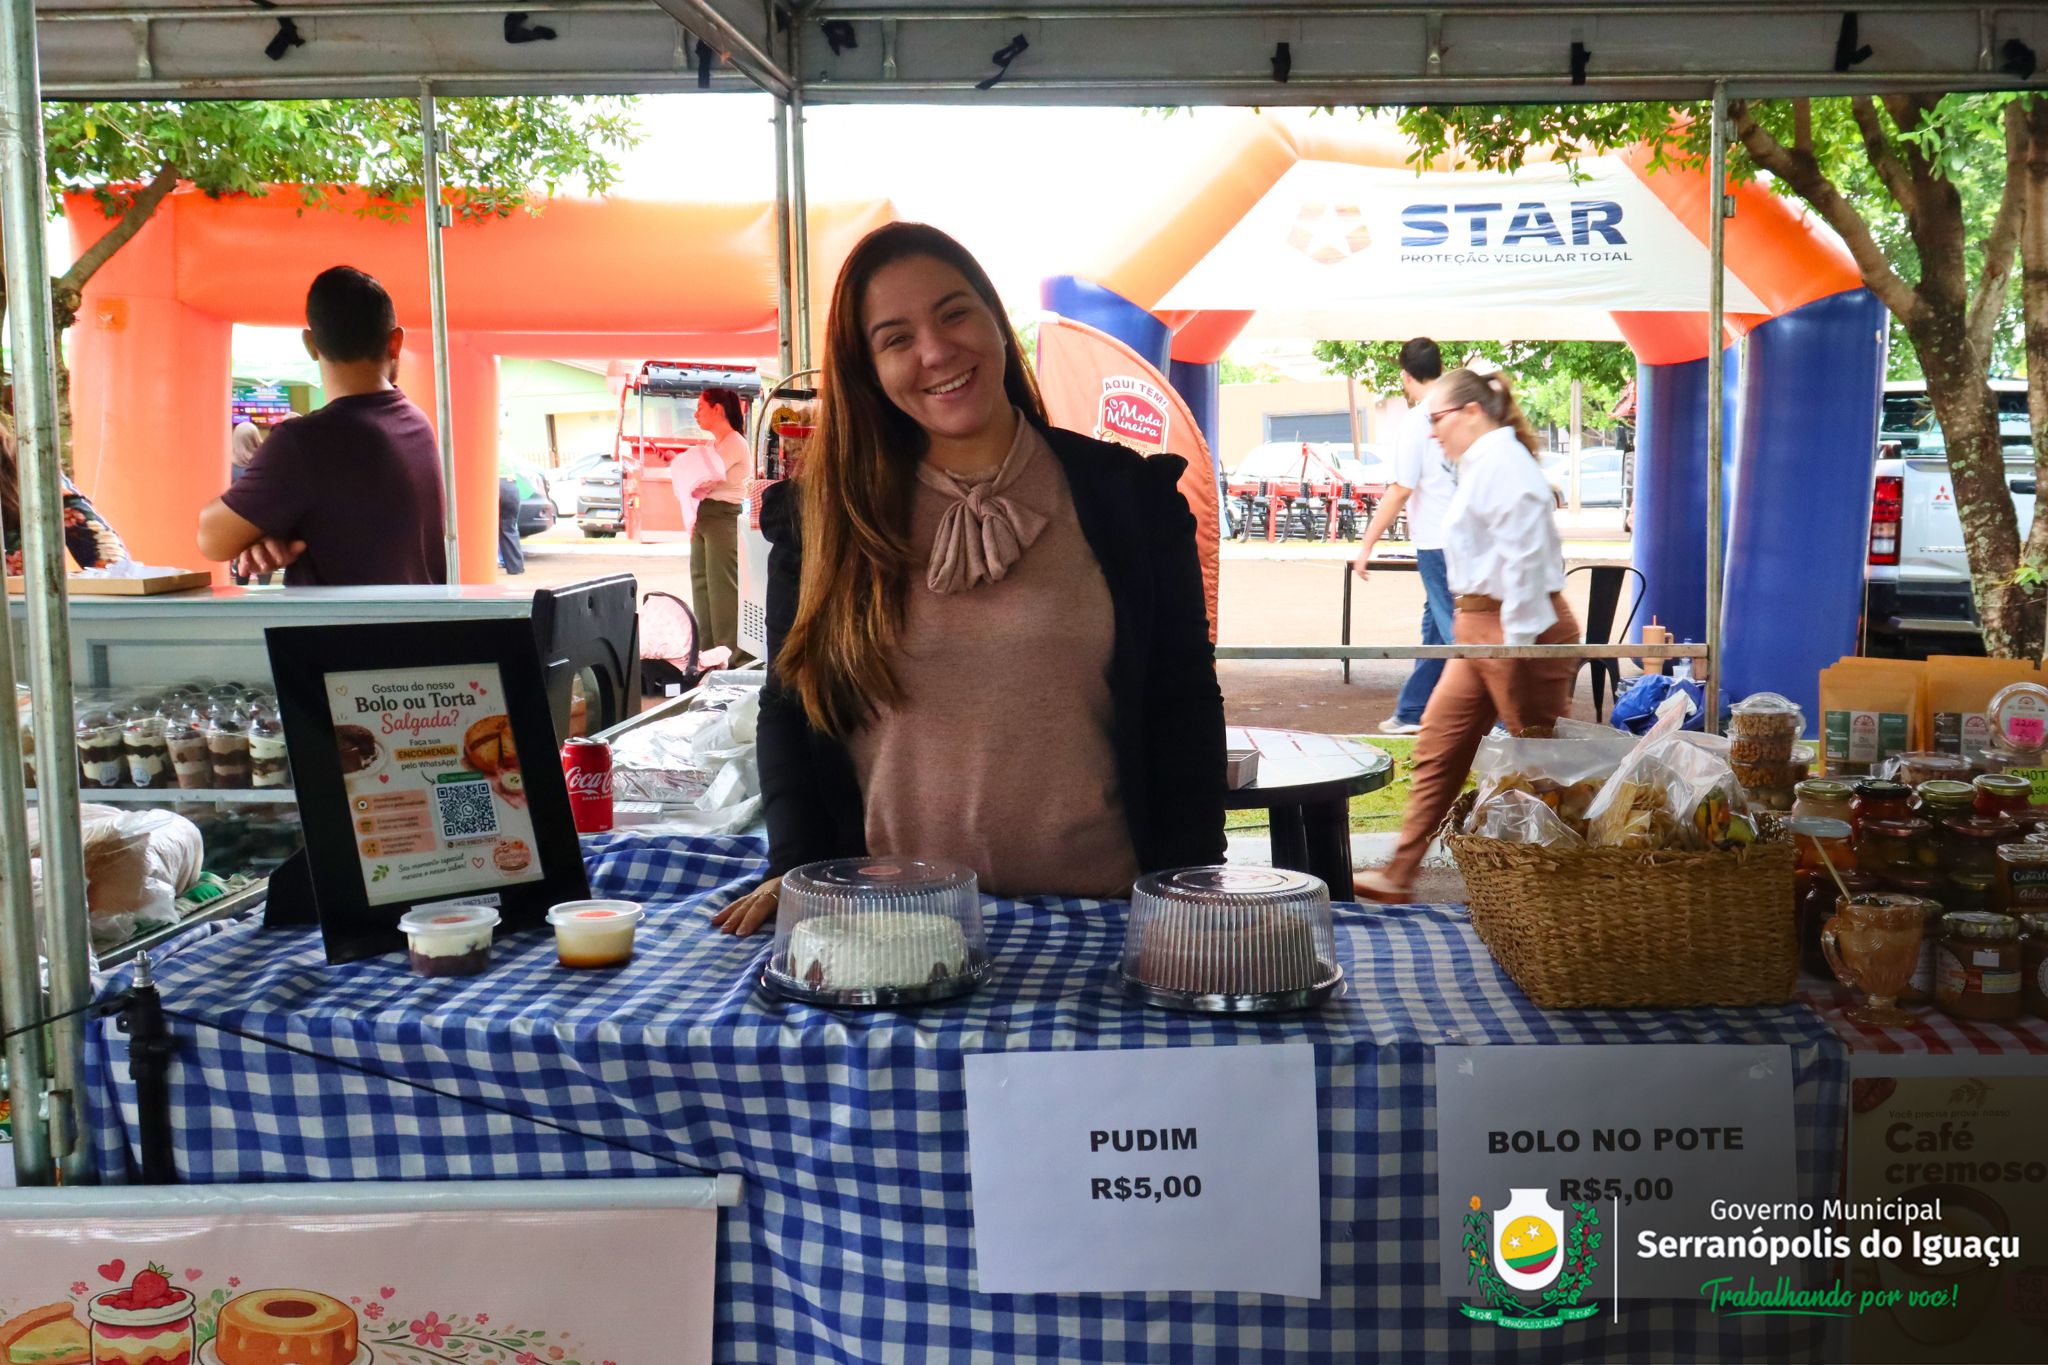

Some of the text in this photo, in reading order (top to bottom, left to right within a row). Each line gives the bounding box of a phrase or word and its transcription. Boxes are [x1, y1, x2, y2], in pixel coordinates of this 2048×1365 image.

[1401, 200, 1628, 246] STAR
[1401, 251, 1633, 265] PROTEÇÃO VEICULAR TOTAL
[1105, 379, 1168, 407] AQUI TEM!
[1105, 406, 1159, 437] Mineira
[1119, 400, 1162, 427] Moda
[372, 681, 455, 694] Gostou do nosso
[355, 692, 476, 713] Bolo ou Torta
[382, 709, 459, 737] Salgada?
[398, 747, 456, 759] ENCOMENDA
[401, 758, 458, 771] pelo WhatsApp!
[1889, 1109, 1912, 1120] Você
[1915, 1110, 1948, 1121] precisa
[1090, 1127, 1198, 1152] PUDIM
[1488, 1127, 1744, 1154] BOLO NO POTE
[1886, 1121, 1975, 1153] Café
[1885, 1160, 2048, 1185] cremoso
[1091, 1175, 1202, 1203] R$5,00
[1560, 1177, 1673, 1206] R$5,00
